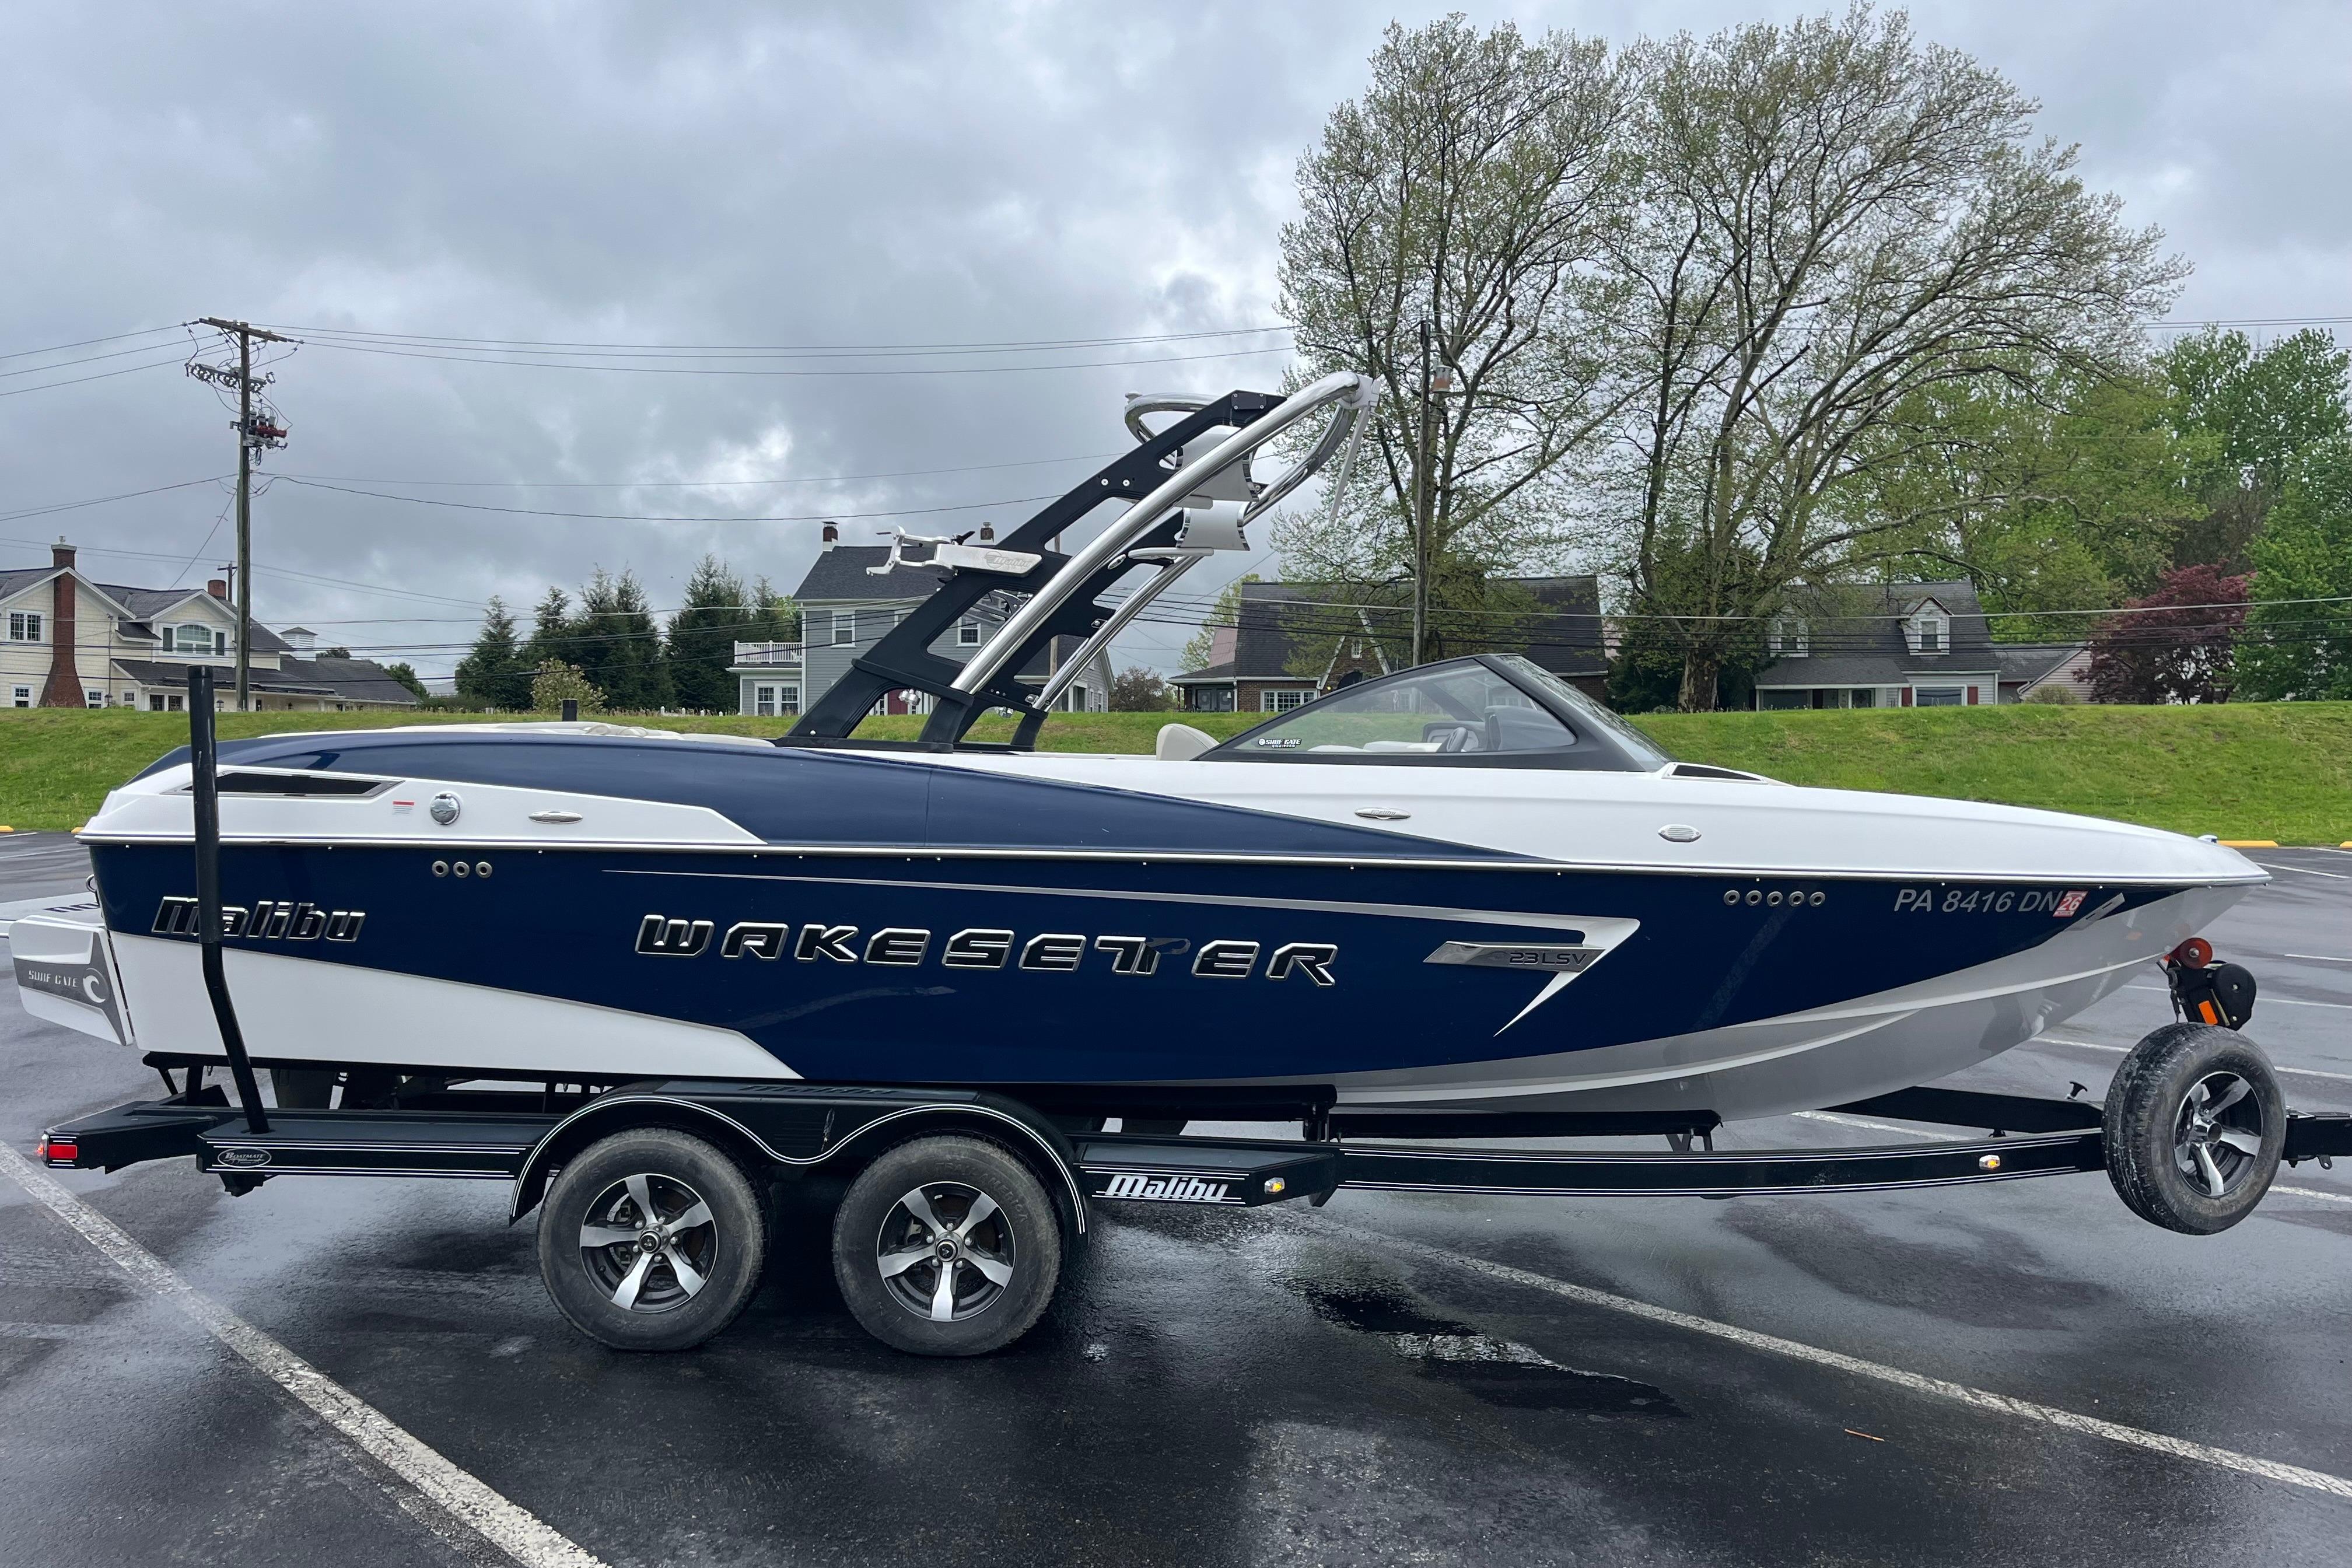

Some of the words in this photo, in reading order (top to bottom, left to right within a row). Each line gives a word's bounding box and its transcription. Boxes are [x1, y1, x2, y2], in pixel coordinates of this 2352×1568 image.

[1894, 888, 1933, 912] PA
[1942, 889, 2015, 913] 8416
[2018, 890, 2063, 912] DN
[2057, 897, 2083, 911] 26
[29, 969, 52, 982] SURF
[1105, 1174, 1229, 1202] Malibu
